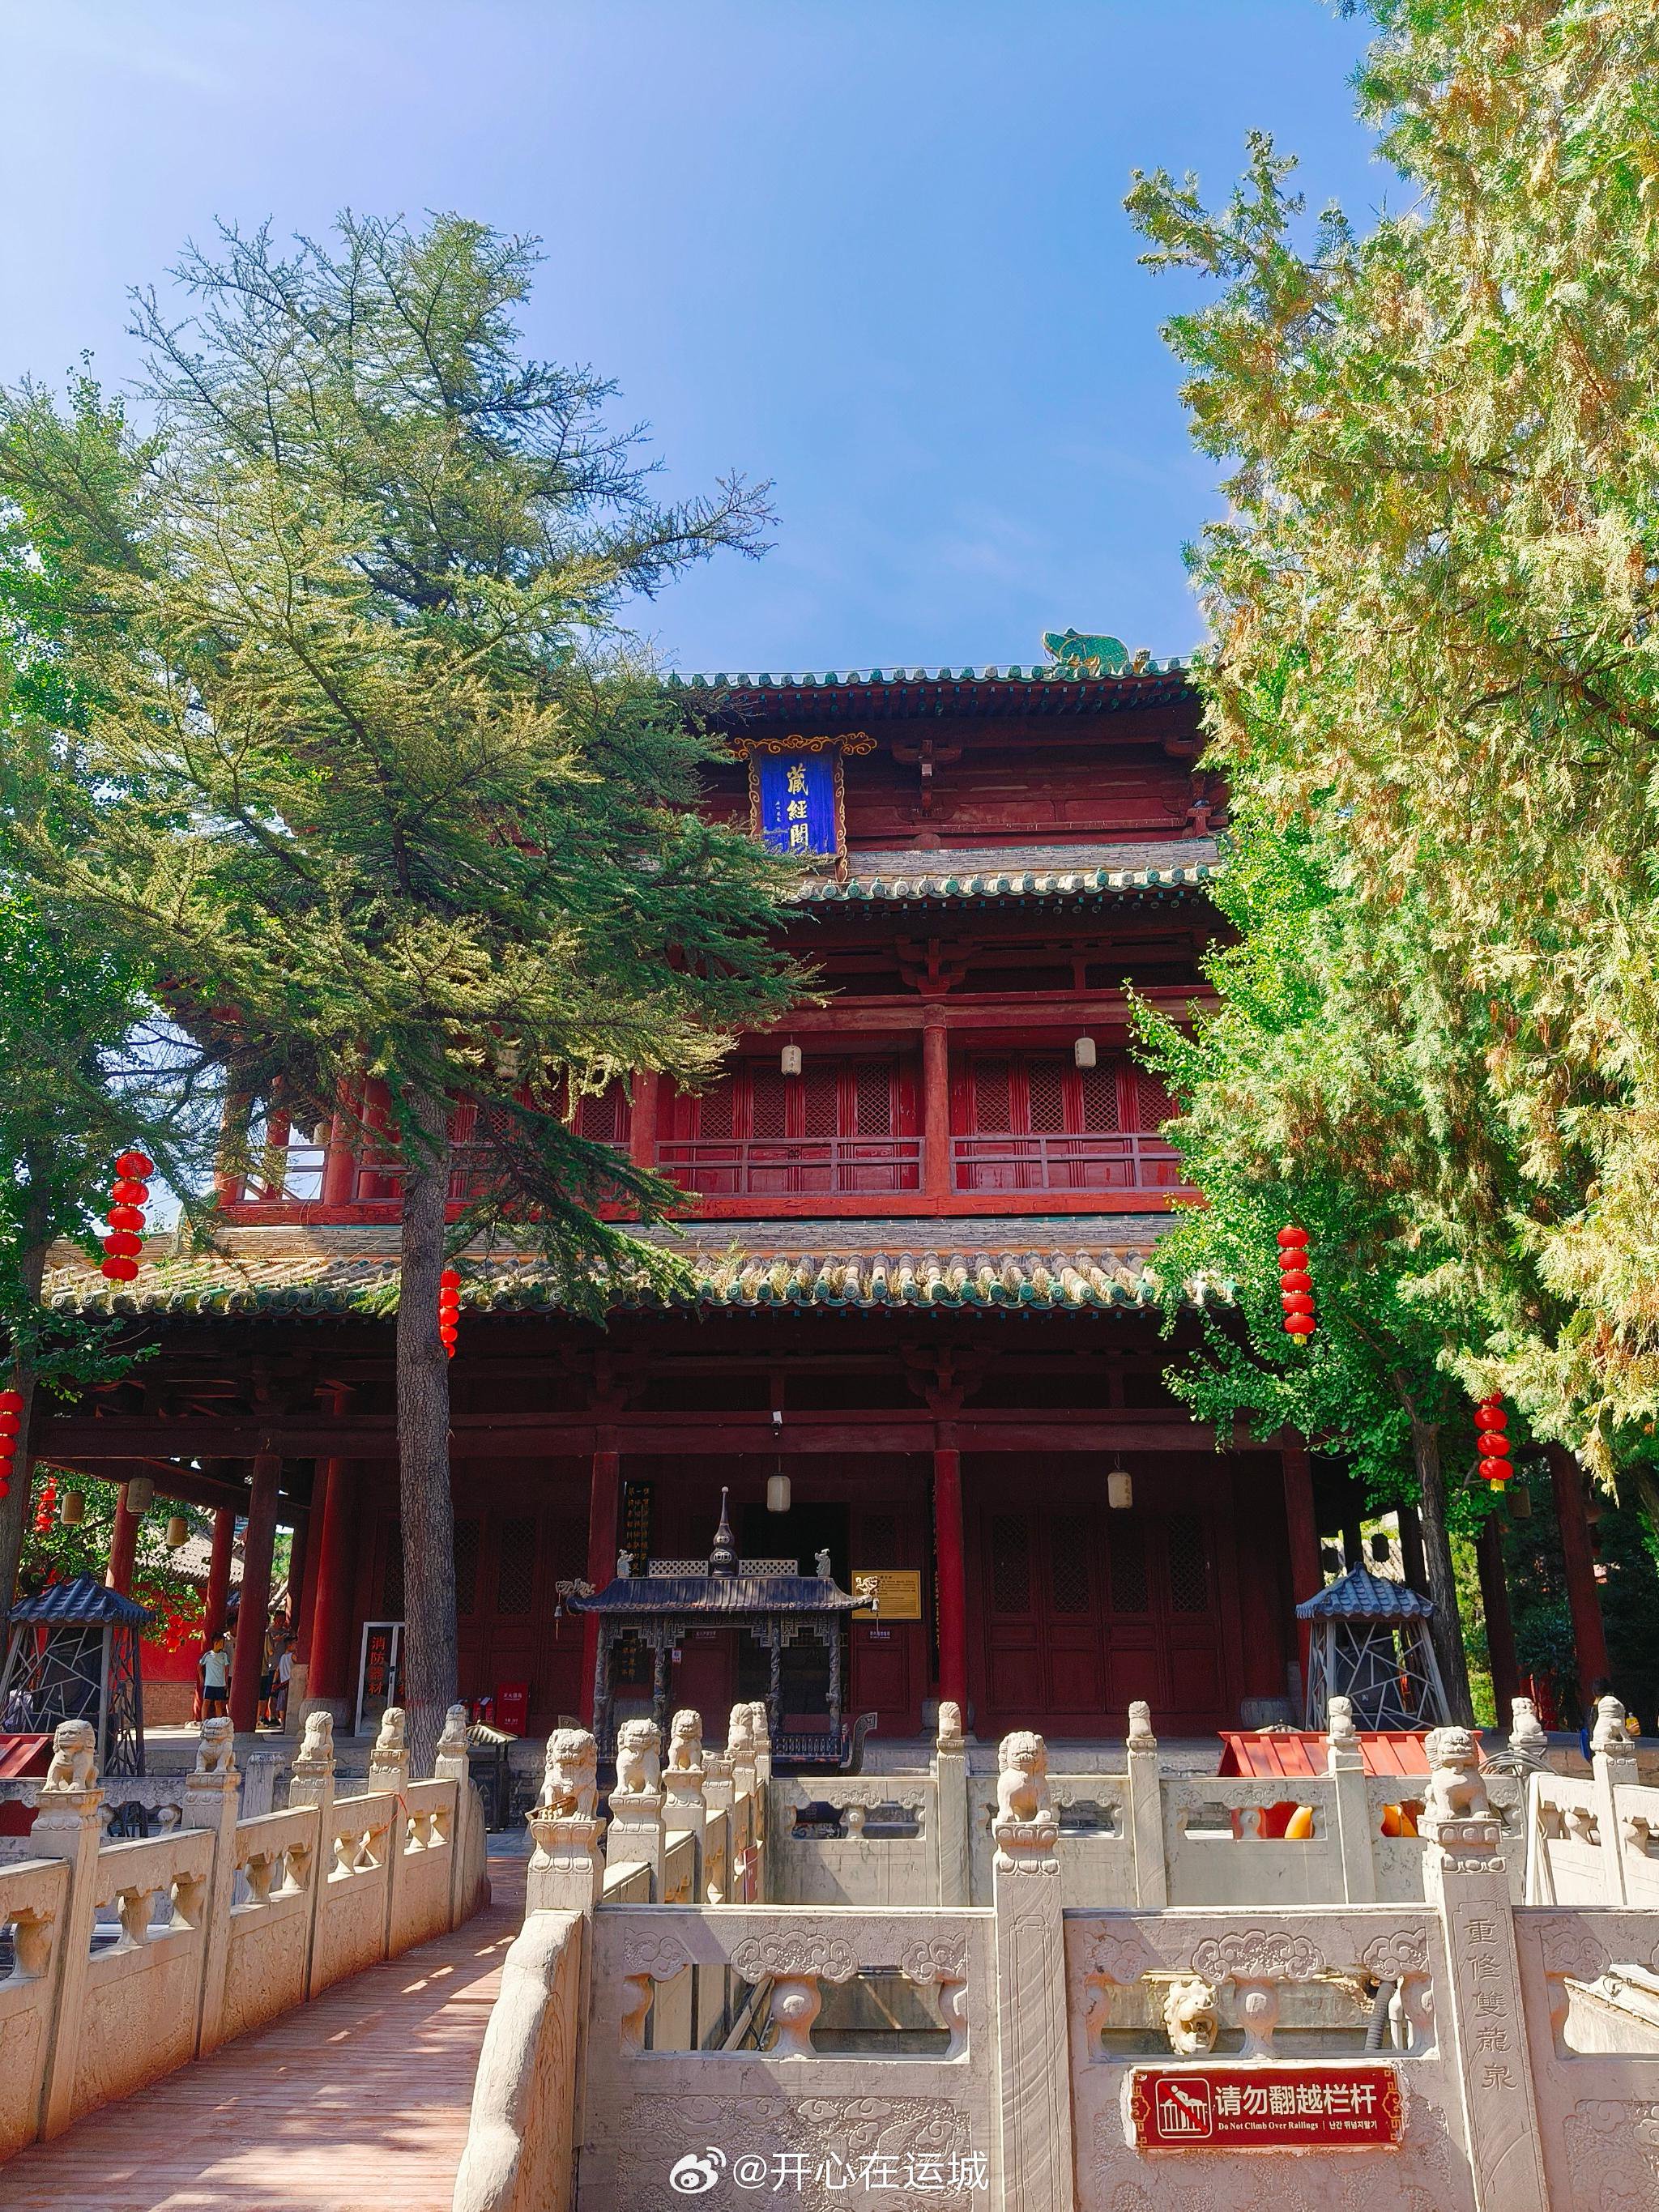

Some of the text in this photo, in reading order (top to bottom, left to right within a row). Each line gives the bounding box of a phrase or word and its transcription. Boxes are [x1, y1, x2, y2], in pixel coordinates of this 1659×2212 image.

[369, 1636, 386, 1696] 消防器材
[1463, 1918, 1518, 2091] 重修雙龍泉
[1215, 2083, 1376, 2116] 请勿翻越栏杆
[1218, 2121, 1319, 2131] Do Not Climb Over Railings
[1328, 2120, 1343, 2130] 난간
